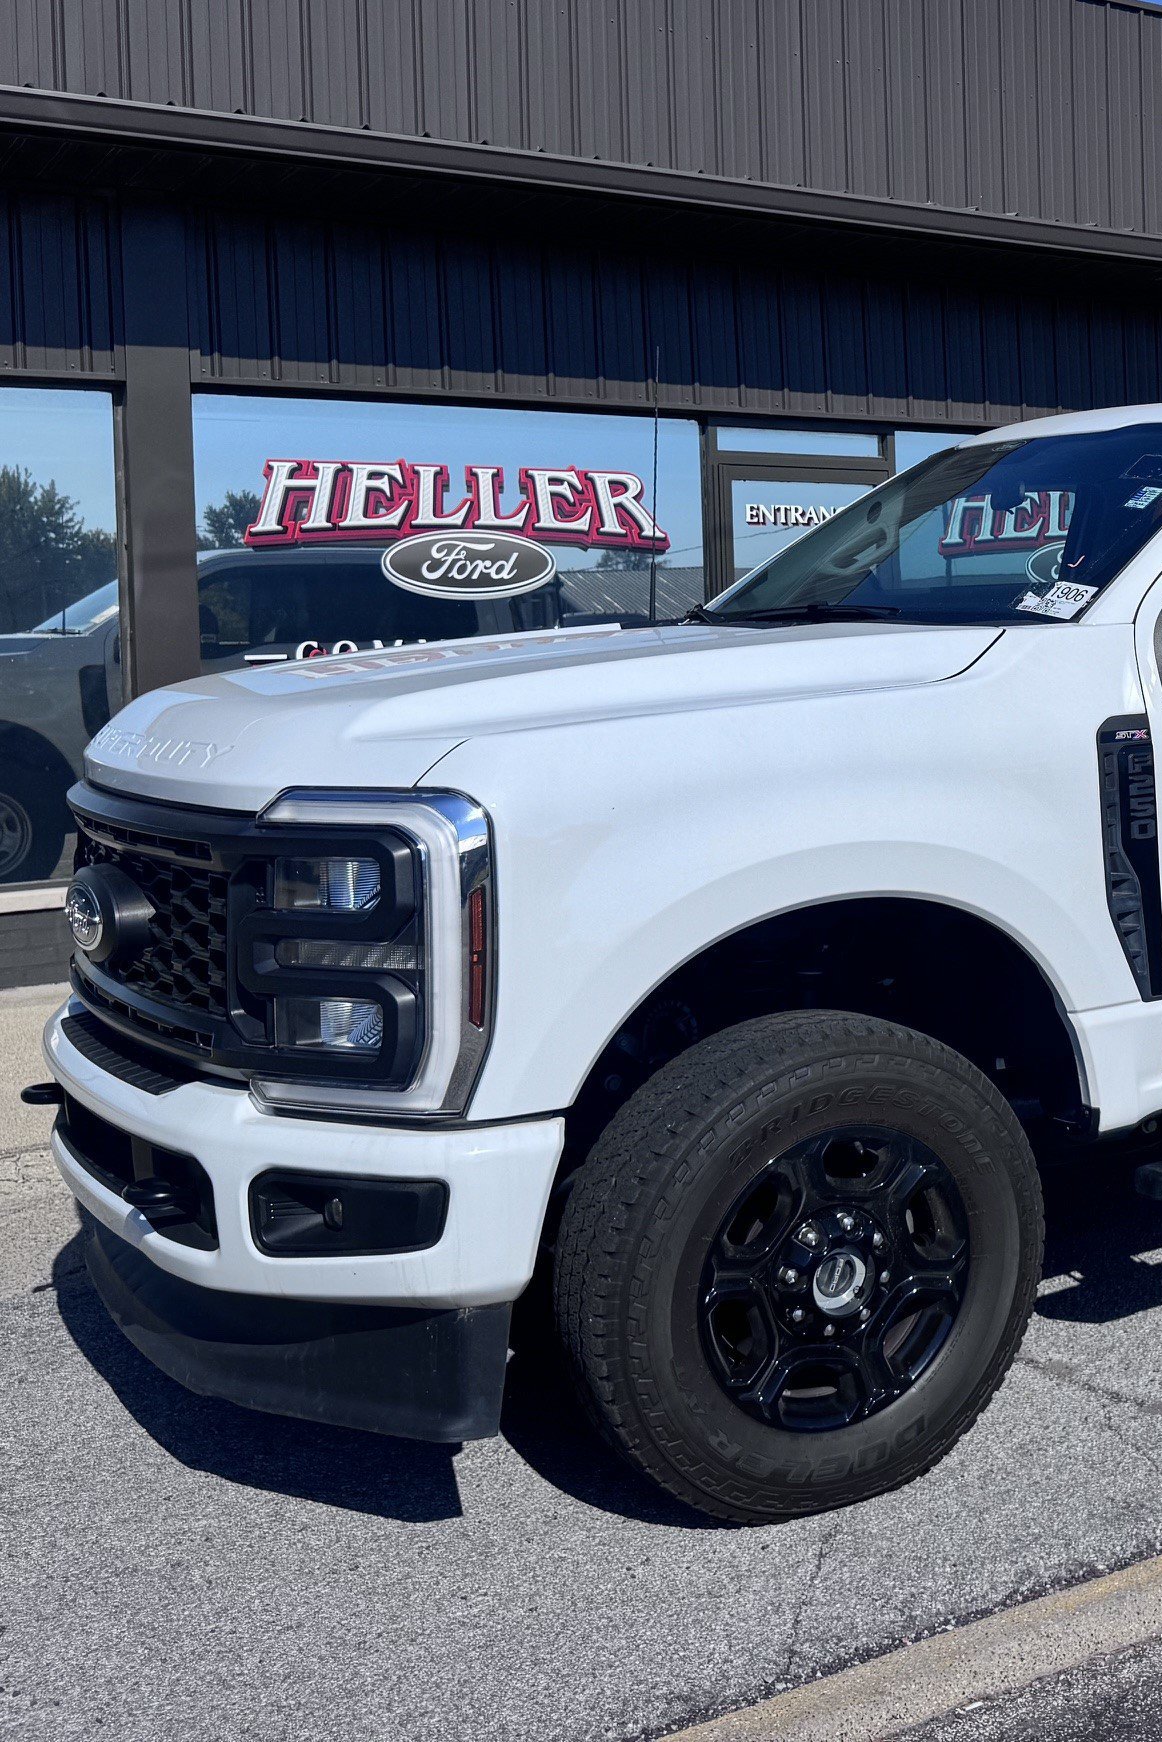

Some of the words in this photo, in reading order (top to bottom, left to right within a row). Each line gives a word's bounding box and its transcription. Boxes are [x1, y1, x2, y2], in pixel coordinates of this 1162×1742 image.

[245, 458, 671, 551] HELLER
[745, 503, 846, 525] ENTRAN
[942, 491, 1076, 545] HEL
[421, 540, 519, 582] Ford
[1051, 585, 1089, 603] 1906
[1115, 728, 1149, 740] STX
[728, 1084, 998, 1178] BRIDGESTONE
[829, 1258, 845, 1292] FORD
[707, 1414, 928, 1484] DUELER
